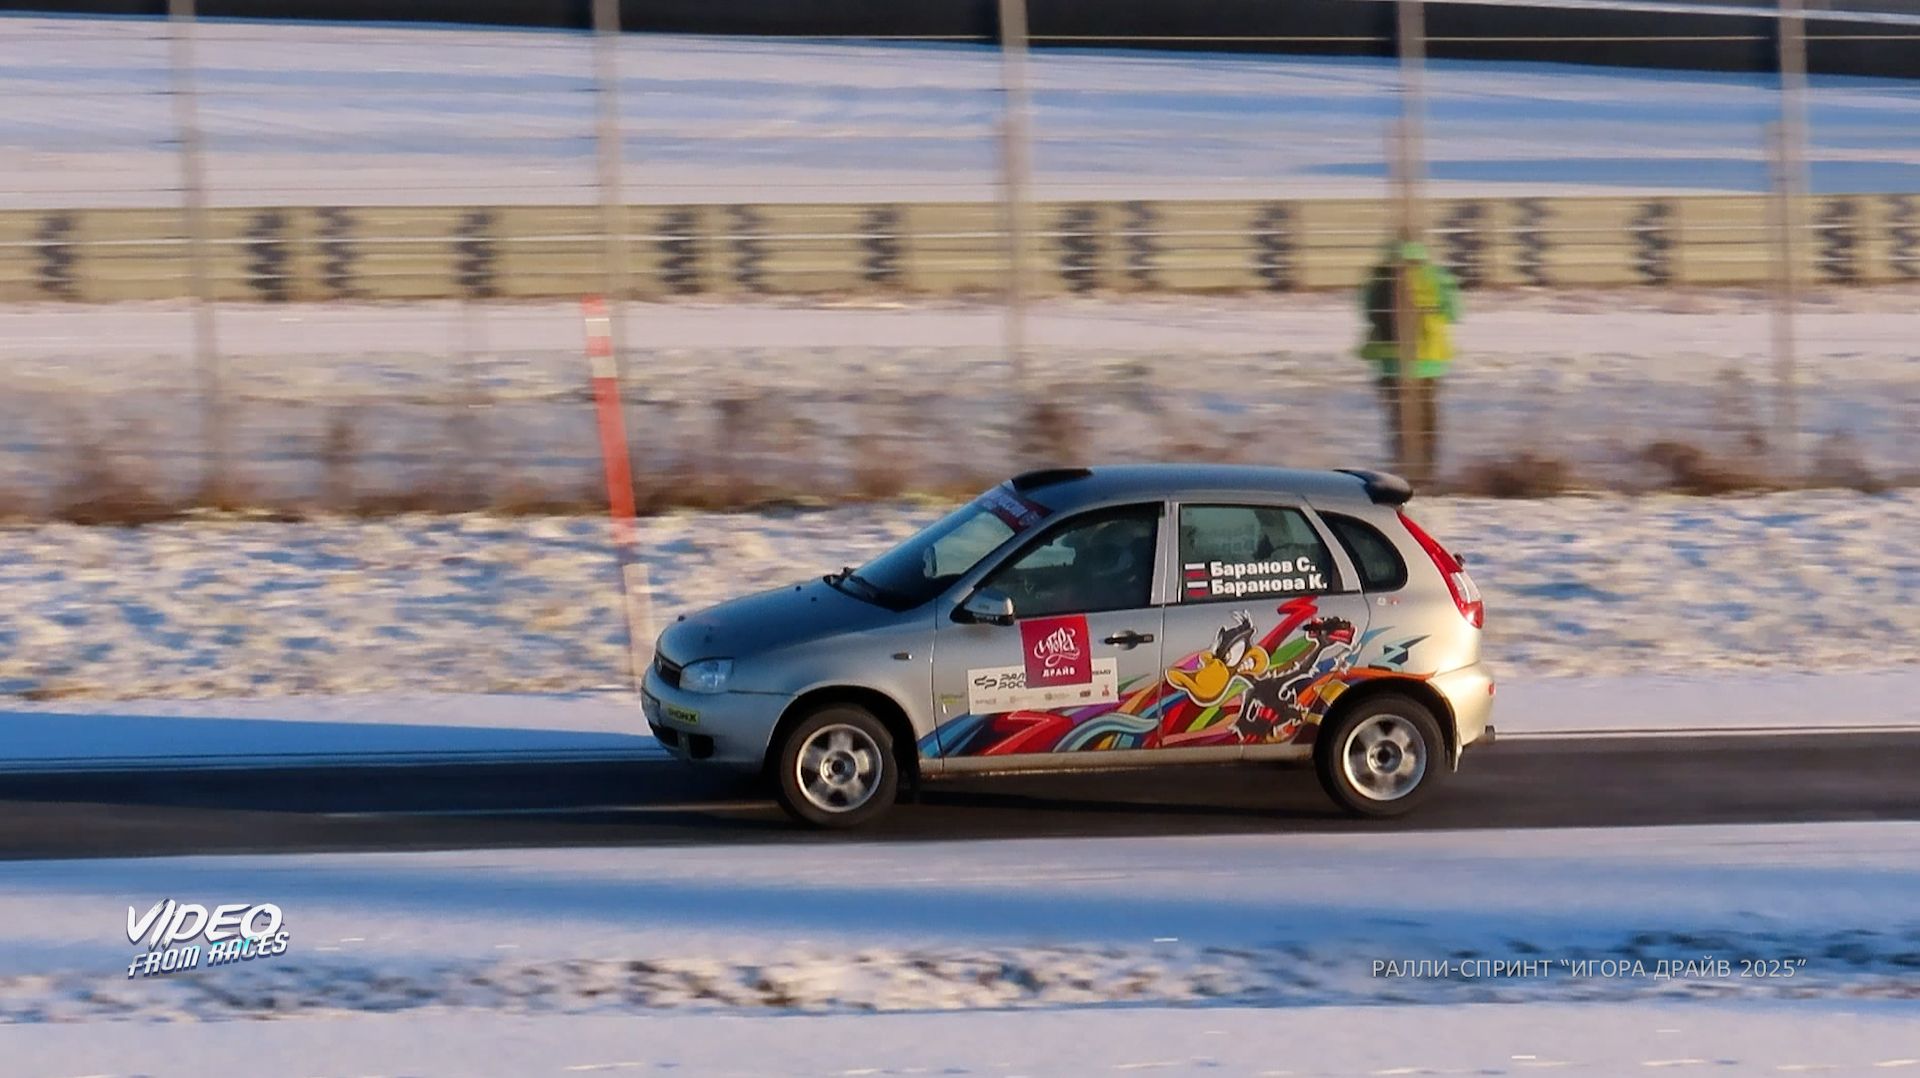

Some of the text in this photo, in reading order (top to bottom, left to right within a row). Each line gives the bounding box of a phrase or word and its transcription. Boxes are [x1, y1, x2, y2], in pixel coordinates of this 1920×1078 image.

[1210, 556, 1316, 579] Баранов С.
[1211, 573, 1328, 597] Баранова К.
[1042, 665, 1076, 678] ДРАЙВ
